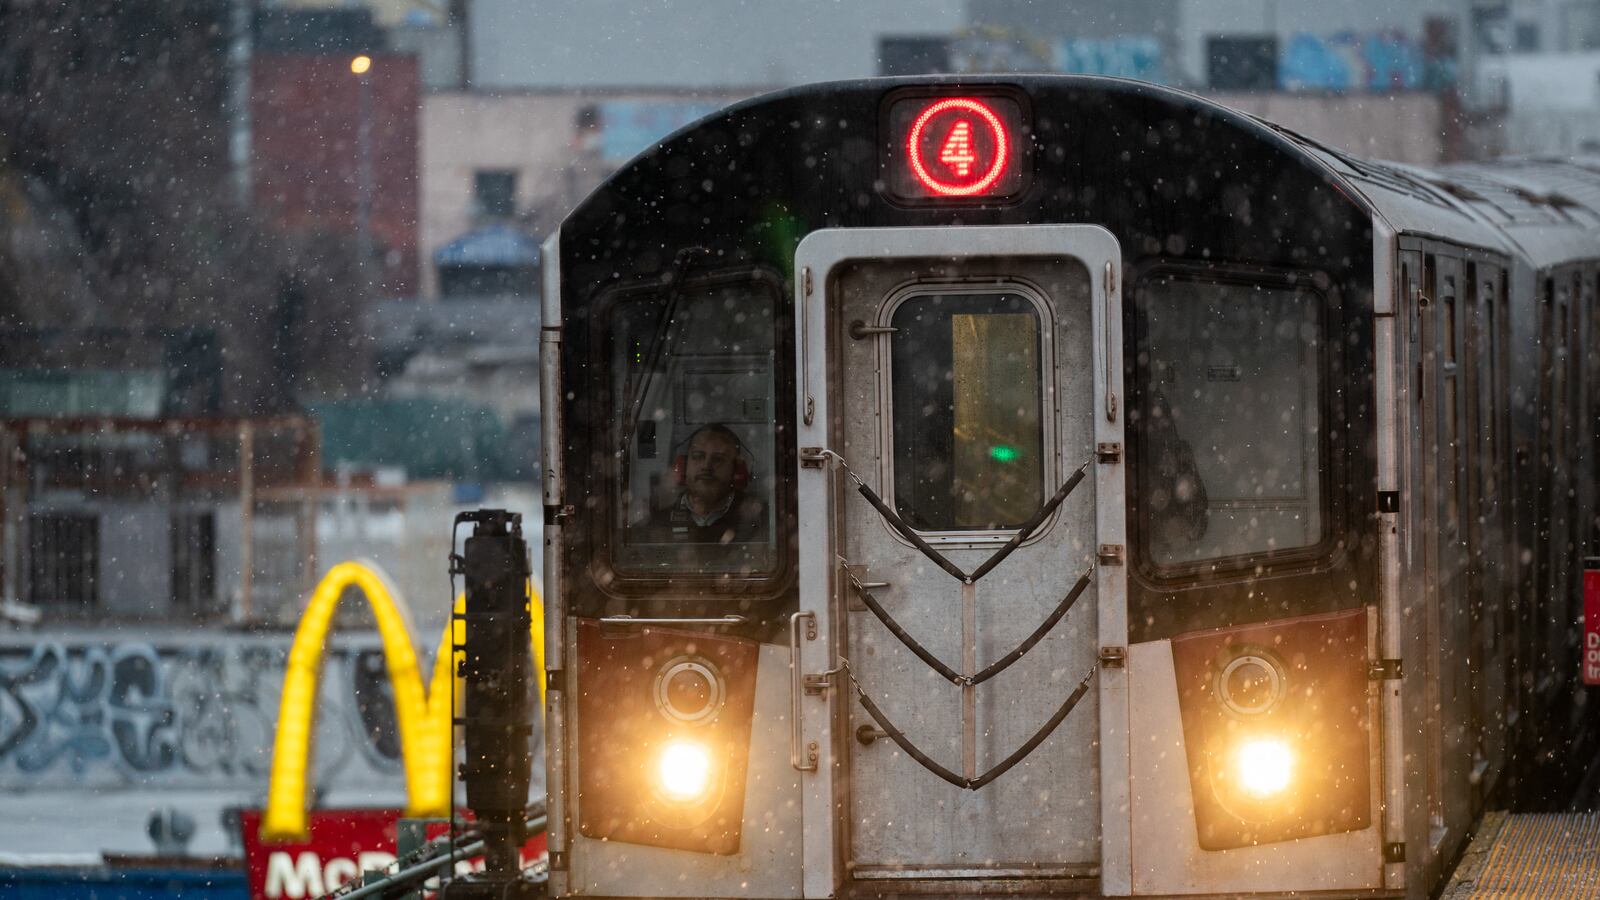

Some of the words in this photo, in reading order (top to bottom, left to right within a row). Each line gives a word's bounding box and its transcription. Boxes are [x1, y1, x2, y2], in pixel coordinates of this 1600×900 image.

[940, 121, 975, 176] 4
[1588, 632, 1600, 648] D
[1588, 650, 1600, 662] o
